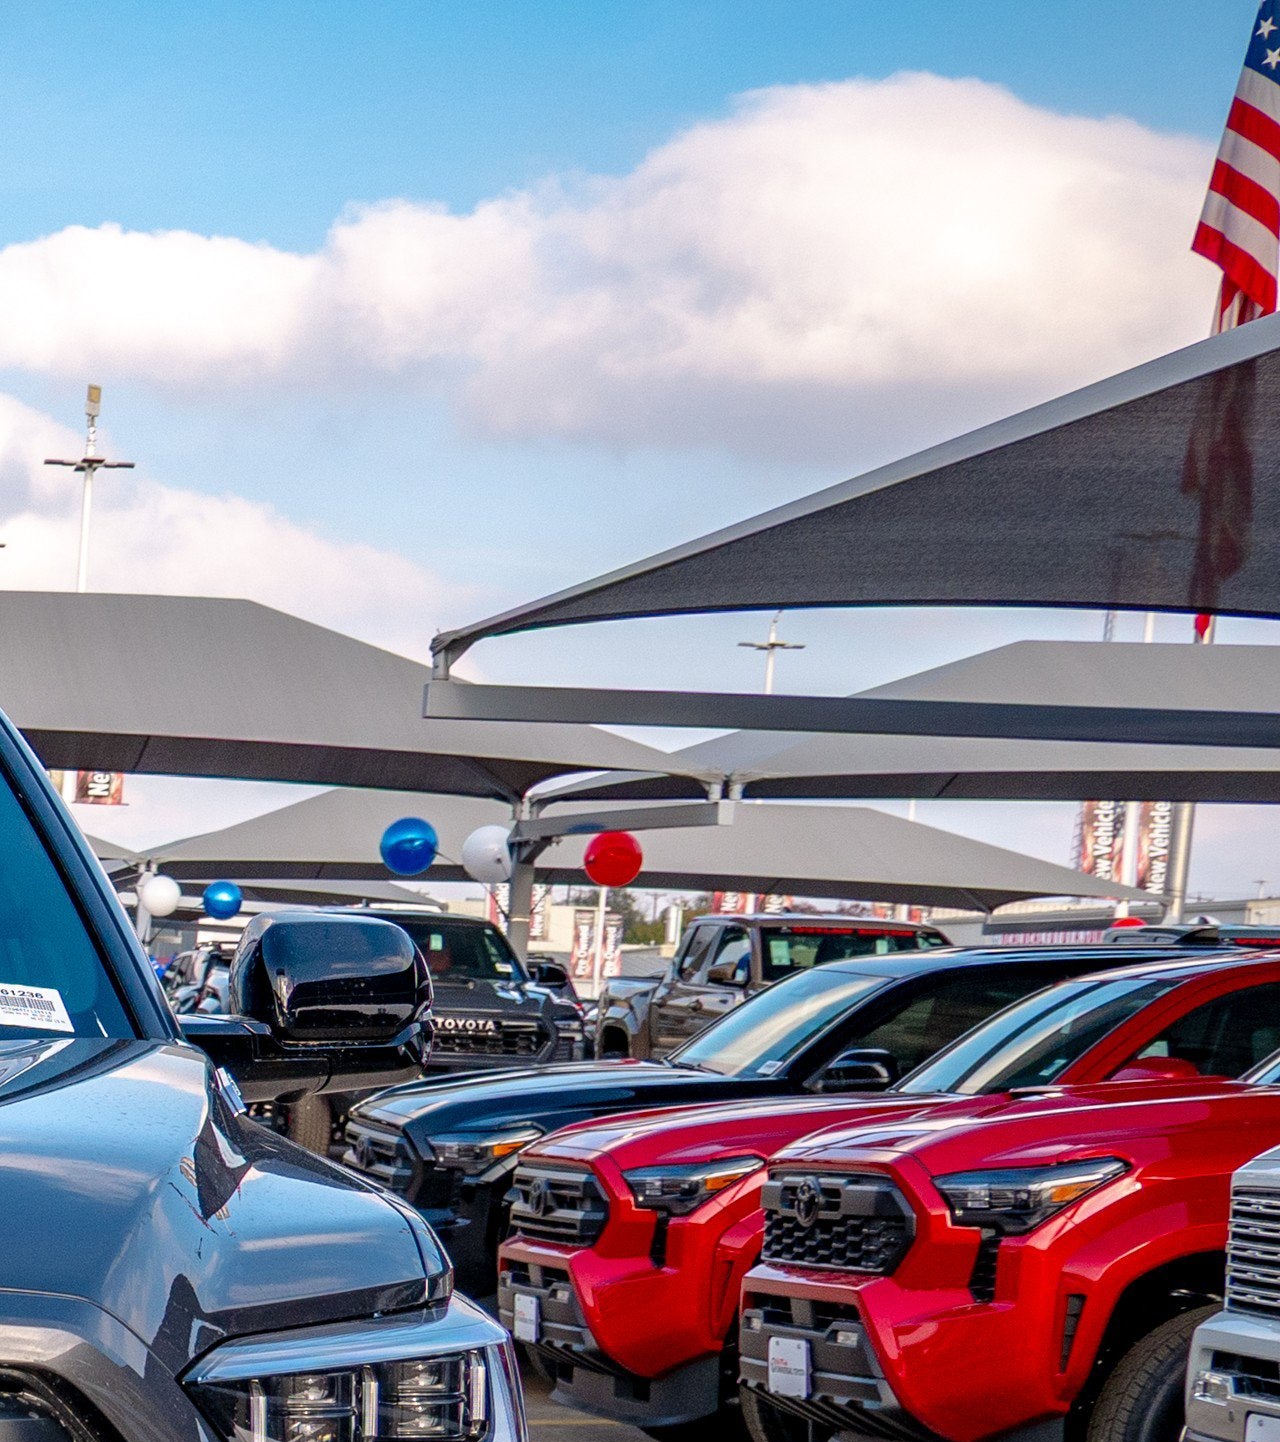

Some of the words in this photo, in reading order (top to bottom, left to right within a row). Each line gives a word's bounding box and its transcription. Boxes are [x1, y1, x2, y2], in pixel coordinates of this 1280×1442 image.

[87, 771, 110, 797] Ne
[1093, 858, 1113, 880] ew
[1145, 859, 1168, 895] New
[434, 1017, 496, 1031] TOYOTA
